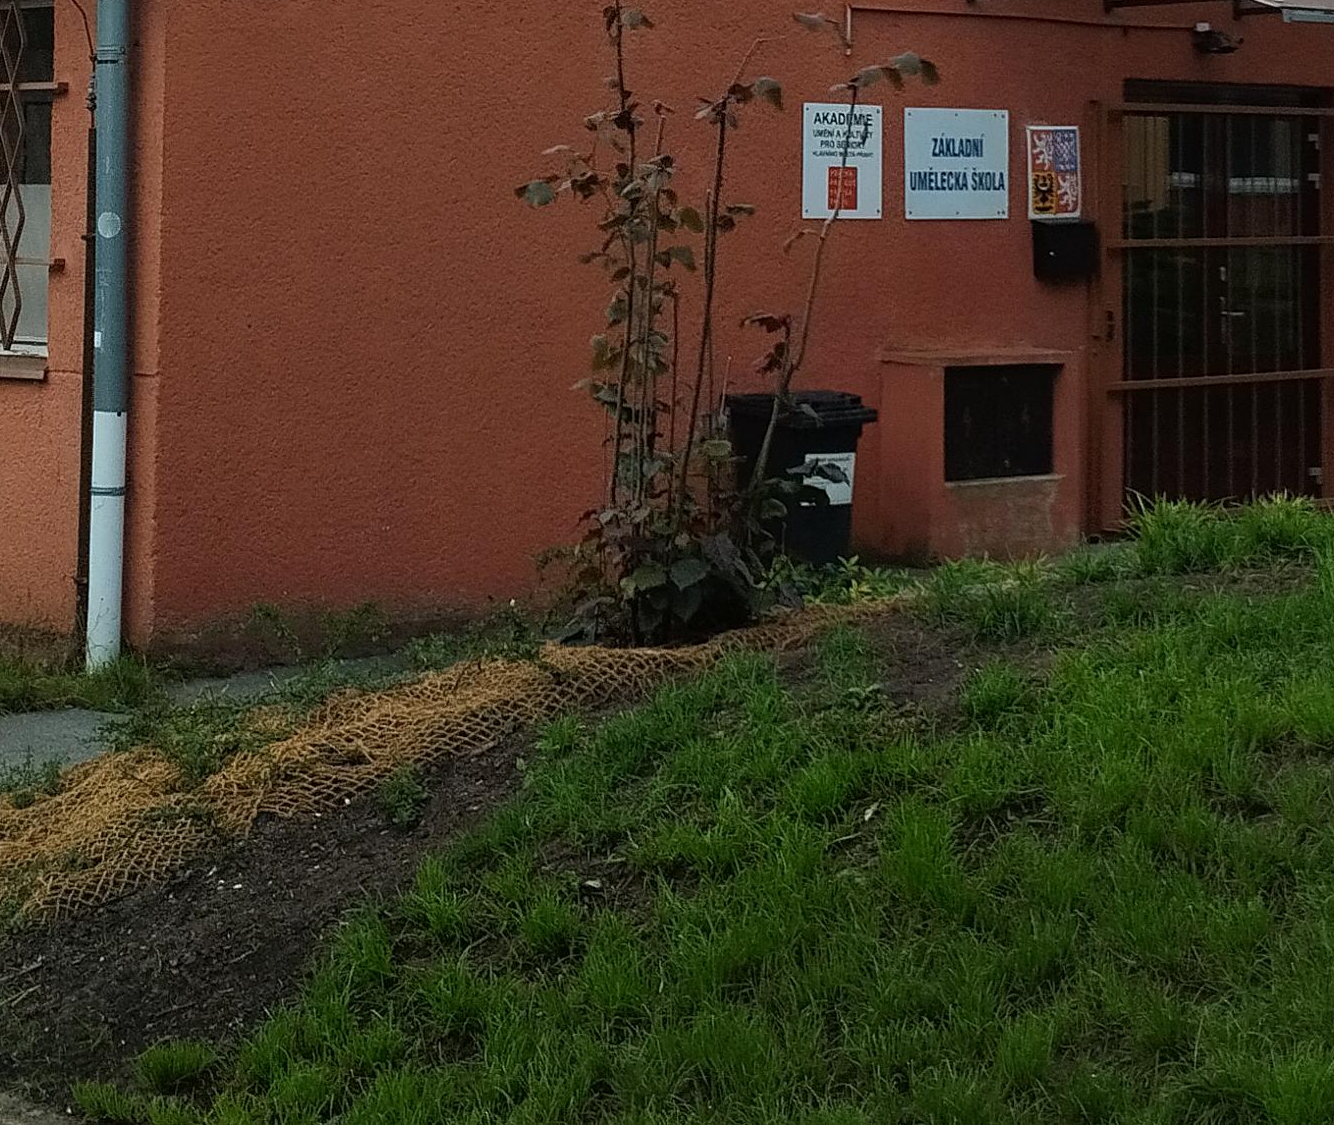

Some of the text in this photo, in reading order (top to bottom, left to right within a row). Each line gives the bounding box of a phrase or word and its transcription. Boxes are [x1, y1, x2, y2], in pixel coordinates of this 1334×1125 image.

[813, 112, 873, 126] AKADEMIE
[931, 132, 985, 157] ZÁKLADNÍ
[910, 166, 1005, 191] UMĚLECKÁ ŠKOLA
